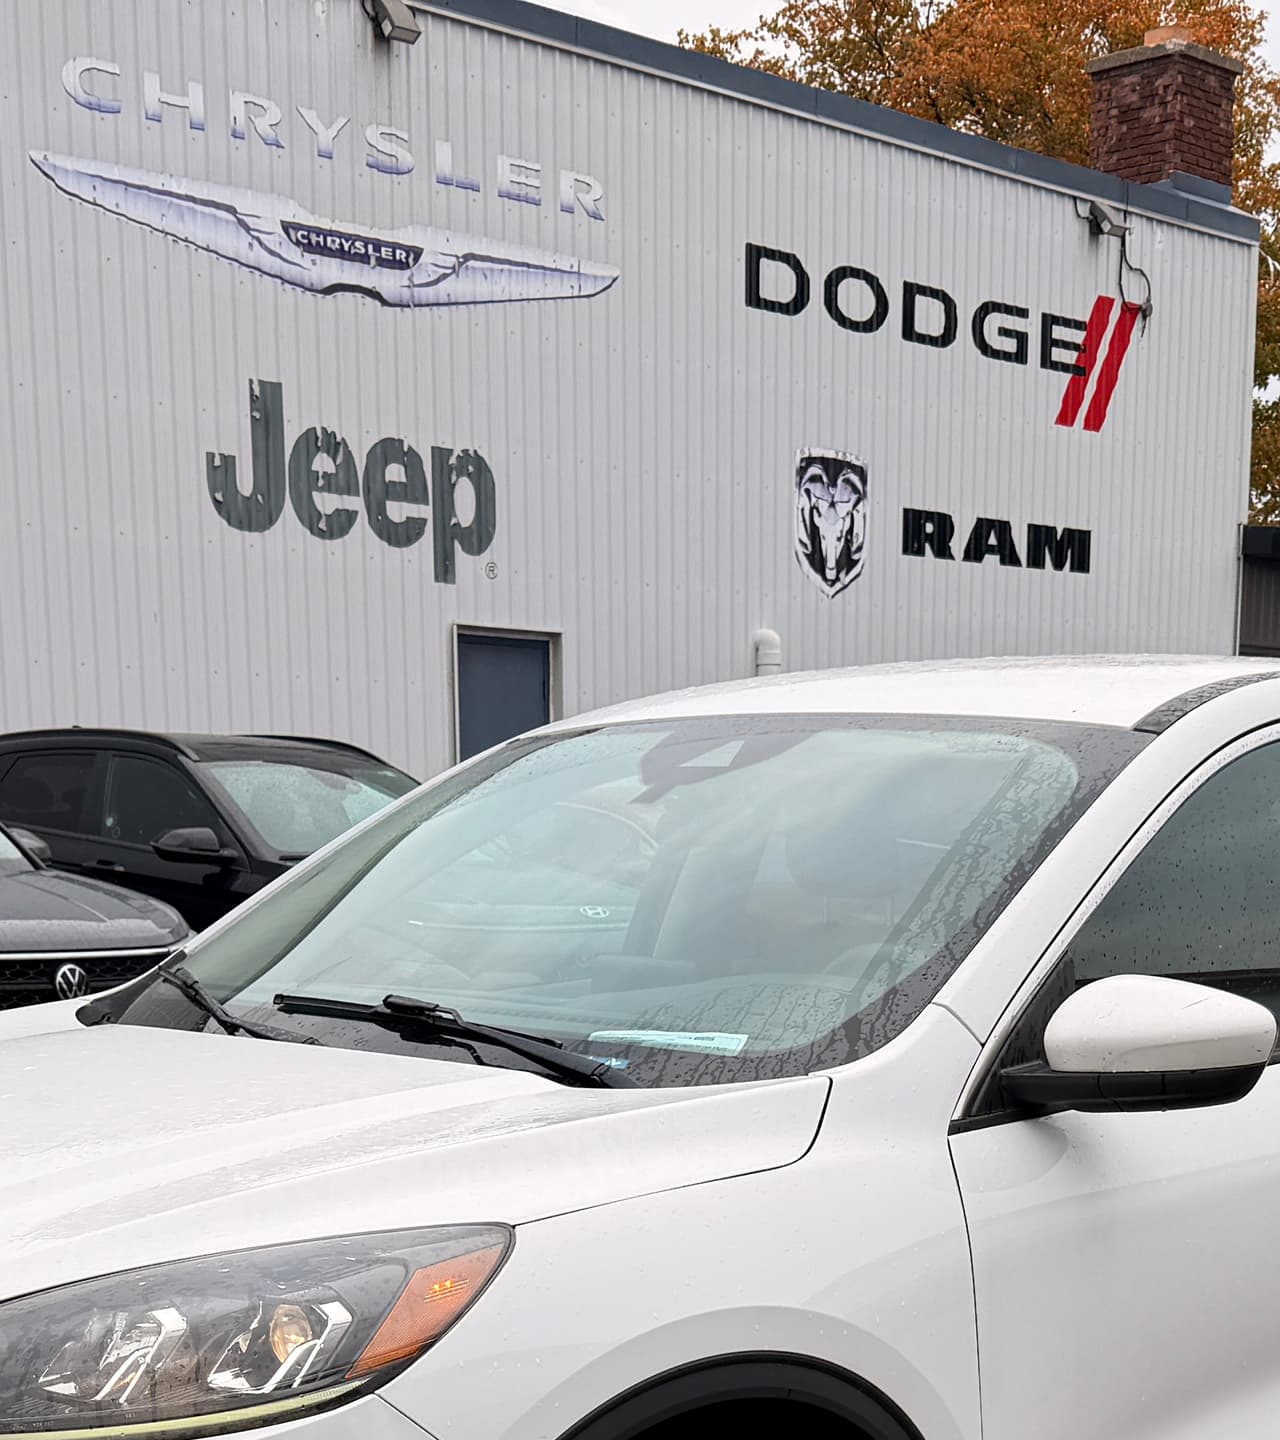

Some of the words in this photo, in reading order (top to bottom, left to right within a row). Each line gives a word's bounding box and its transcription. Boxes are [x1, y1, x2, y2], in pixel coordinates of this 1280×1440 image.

[61, 56, 607, 222] CHRYSLER
[296, 229, 407, 263] CHRYSLER
[744, 241, 1088, 377] DODGE
[205, 377, 497, 585] Jeep
[901, 507, 1092, 575] RAM
